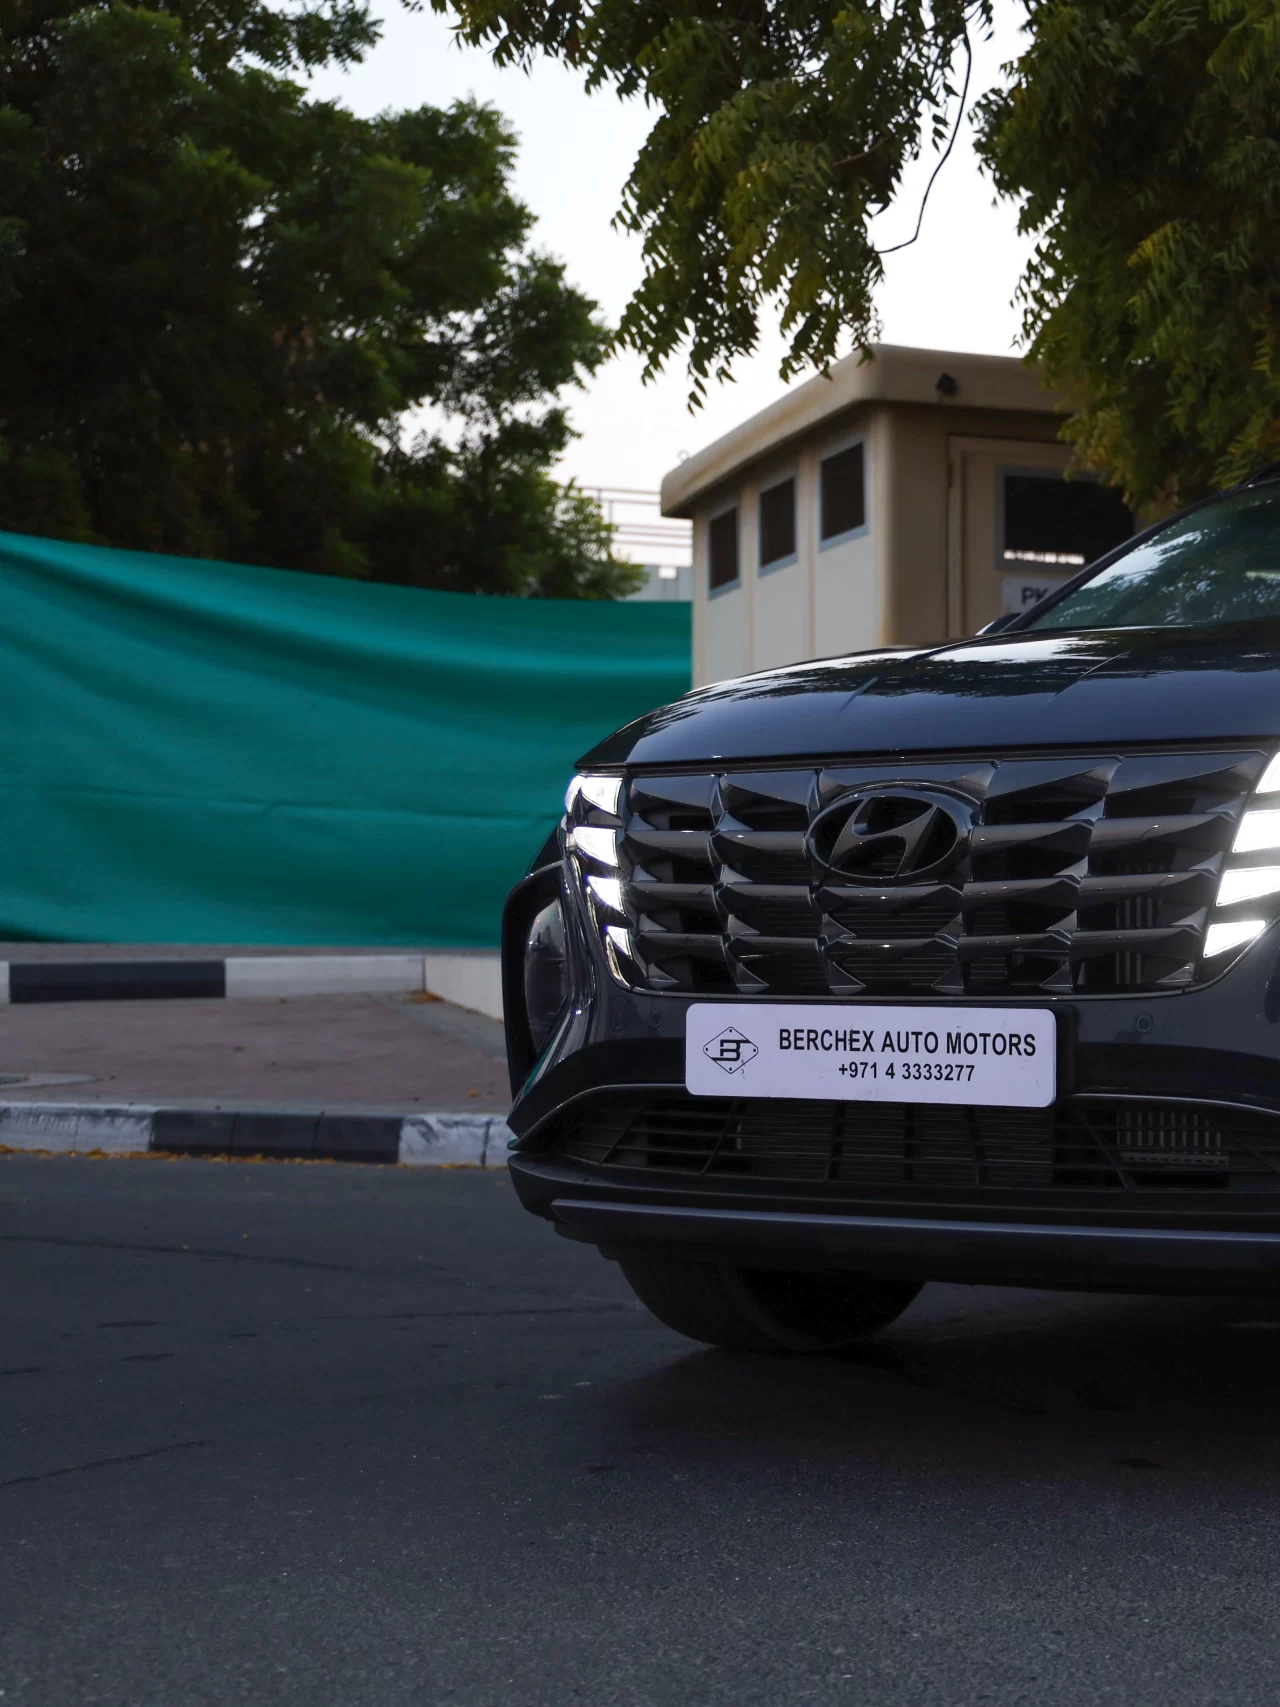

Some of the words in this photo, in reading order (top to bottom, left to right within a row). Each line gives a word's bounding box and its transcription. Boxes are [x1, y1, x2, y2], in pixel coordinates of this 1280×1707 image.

[779, 1028, 875, 1052] BERCHEX
[881, 1031, 939, 1054] AUTO
[946, 1031, 1036, 1057] MOTORS
[838, 1061, 877, 1079] +971
[885, 1062, 896, 1080] 4
[901, 1062, 975, 1082] 3333277
